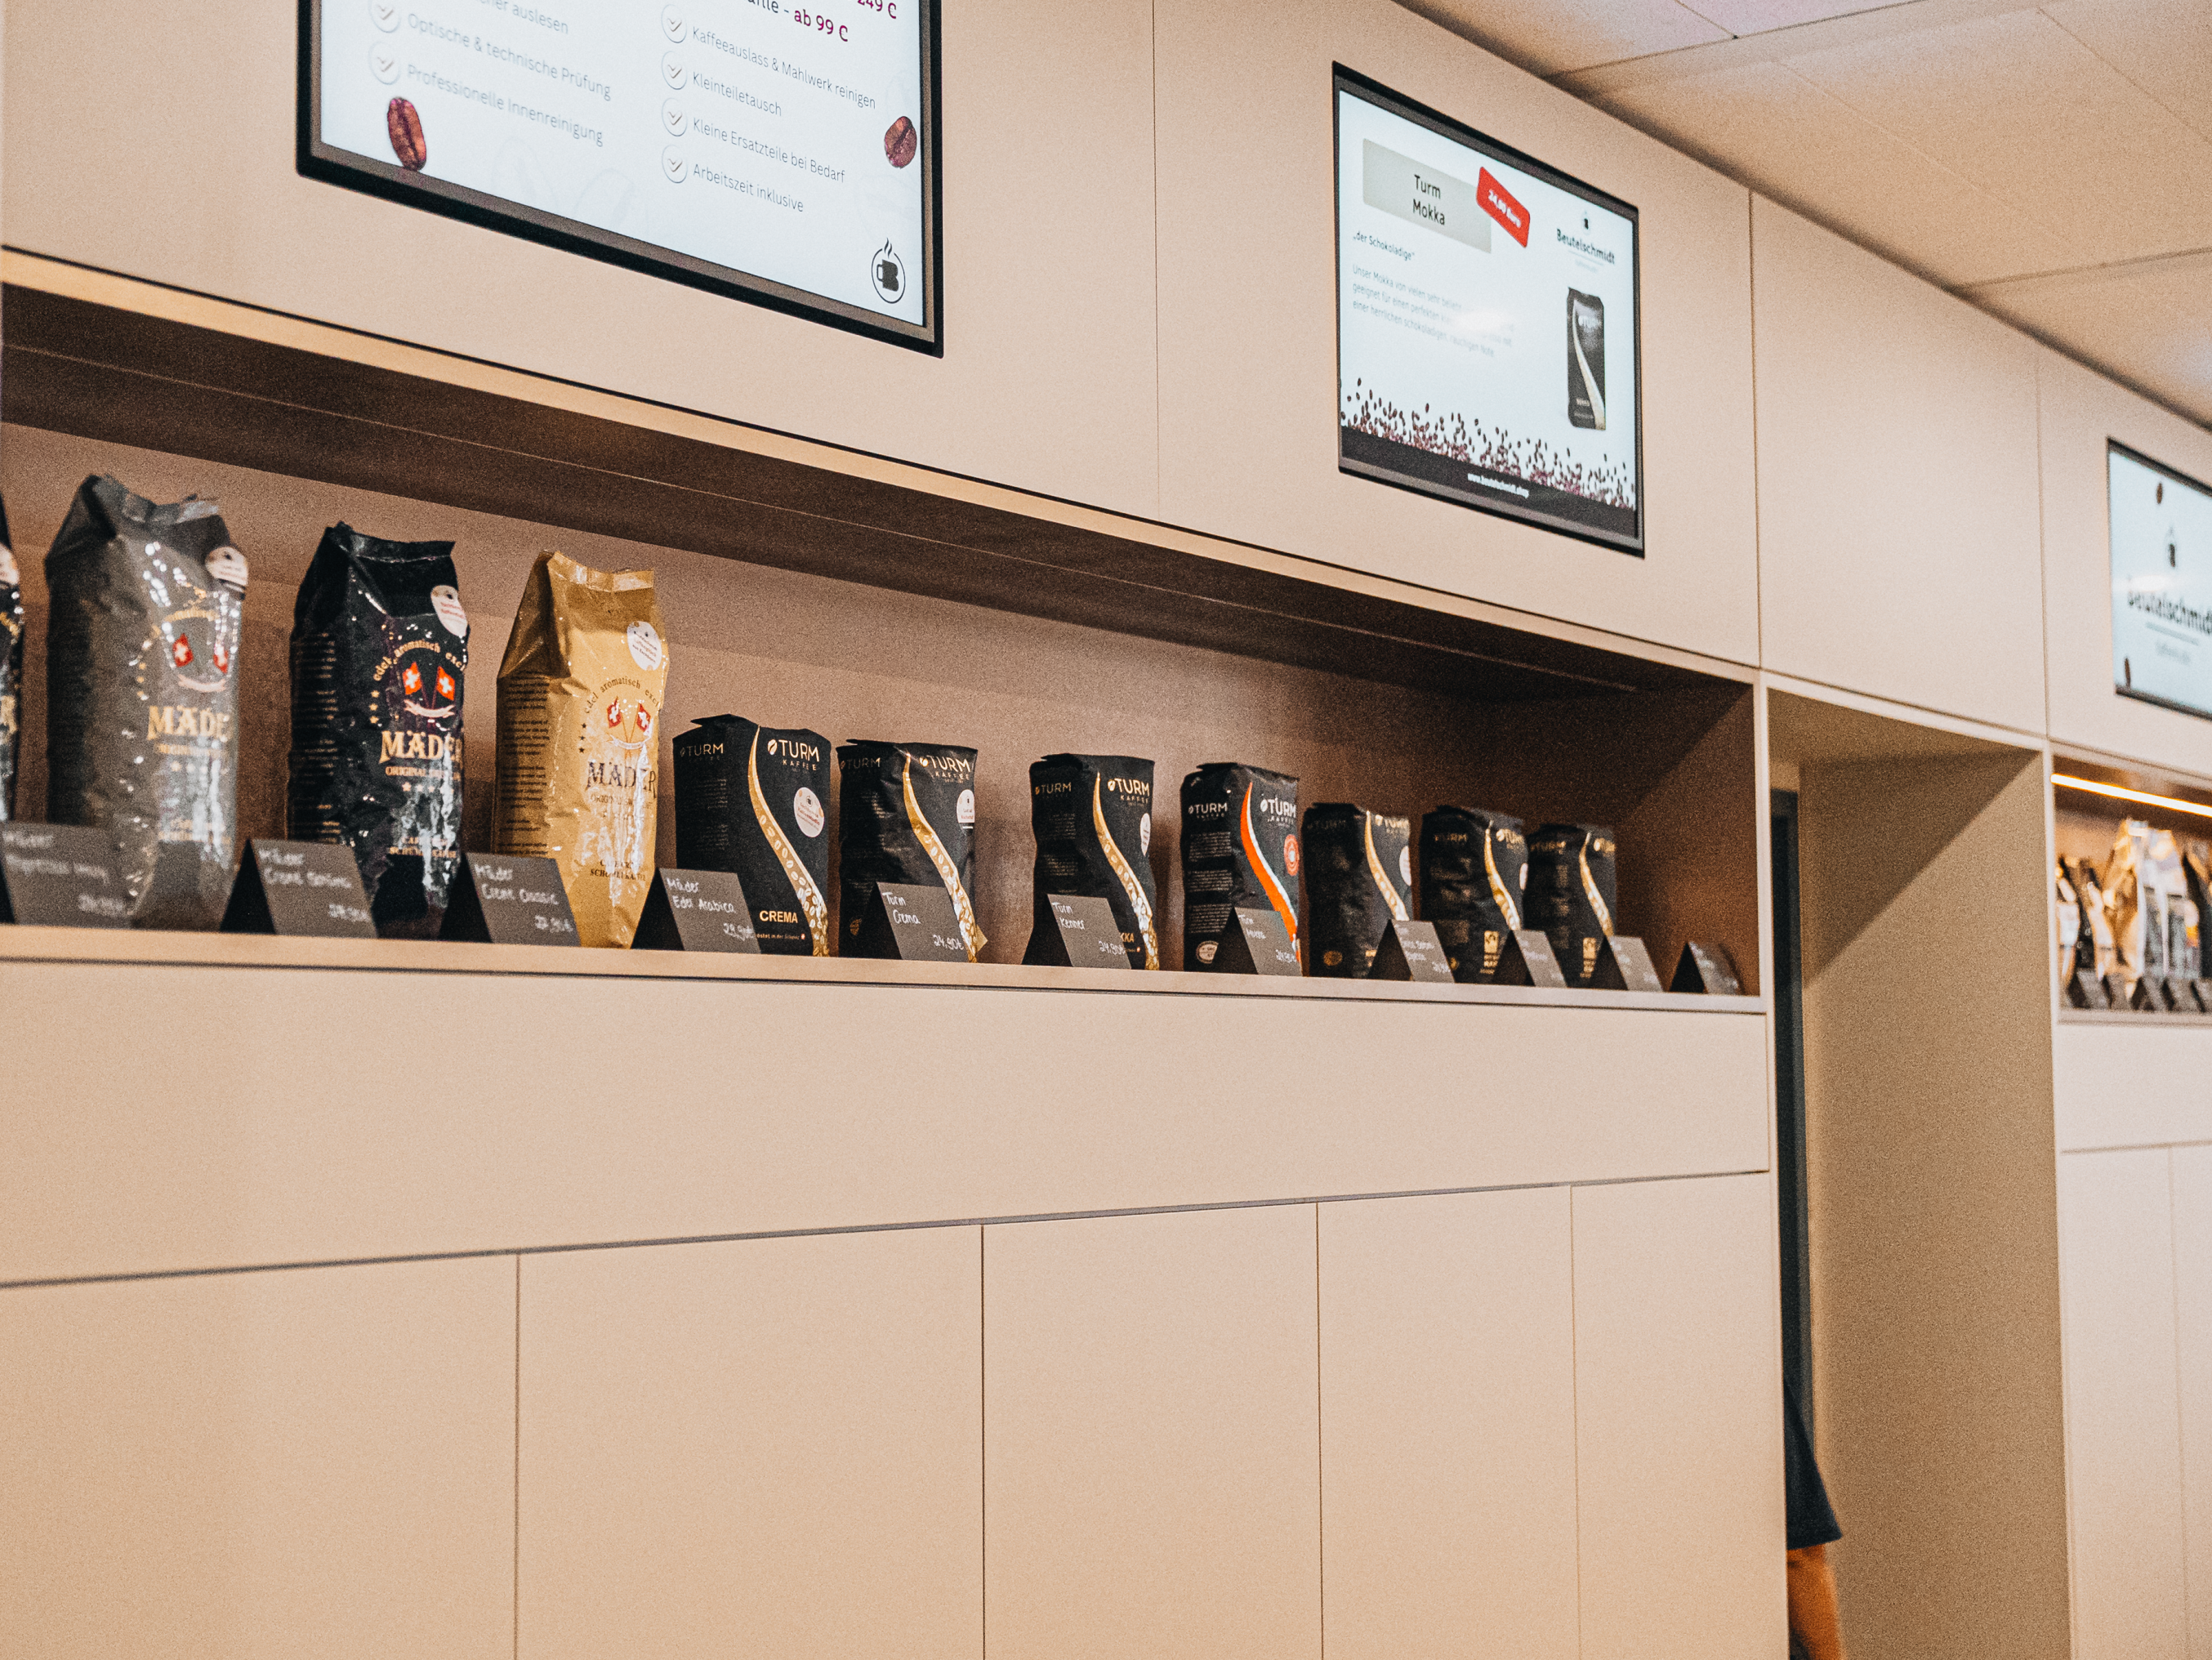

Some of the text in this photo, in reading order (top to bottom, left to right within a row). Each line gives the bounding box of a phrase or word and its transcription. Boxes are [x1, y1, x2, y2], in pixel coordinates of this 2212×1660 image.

[512, 4, 569, 34] auslesen
[794, 9, 811, 26] ab
[815, 15, 834, 34] 99
[408, 13, 611, 101] Optische & technische Prüfung
[693, 27, 876, 109] Kaffeeauslass & Mahlwerk reinigen
[693, 72, 782, 116] Kleinteiletausch
[408, 65, 604, 147] Professionelle Innenreinigung
[693, 118, 845, 183] Kleine Ersatzteile bei Bedarf
[693, 163, 804, 212] Arbeitszeit inklusive
[1414, 174, 1441, 199] Turm
[1412, 199, 1445, 225] Mokka
[1556, 227, 1616, 265] Beutelschmidt
[1353, 264, 1371, 279] Unser
[1373, 271, 1394, 288] Mokka
[1353, 283, 1380, 301] geeignet
[600, 676, 641, 693] aromatisch
[687, 743, 725, 757] TURM
[778, 739, 820, 762] TURM
[782, 759, 818, 771] KAFFEE
[846, 757, 881, 769] TURM
[925, 755, 972, 773] TURM
[1041, 782, 1072, 794] TURM
[1113, 778, 1150, 797] TURM
[1195, 802, 1229, 814] TURM
[1268, 797, 1297, 818] TURM
[666, 877, 699, 893] Mäder
[698, 898, 737, 914] Arabica
[882, 891, 907, 907] Turm
[1051, 901, 1074, 914] Turm
[759, 910, 799, 924] CREMA
[892, 908, 922, 925] Crema
[1059, 917, 1086, 931] Kenner
